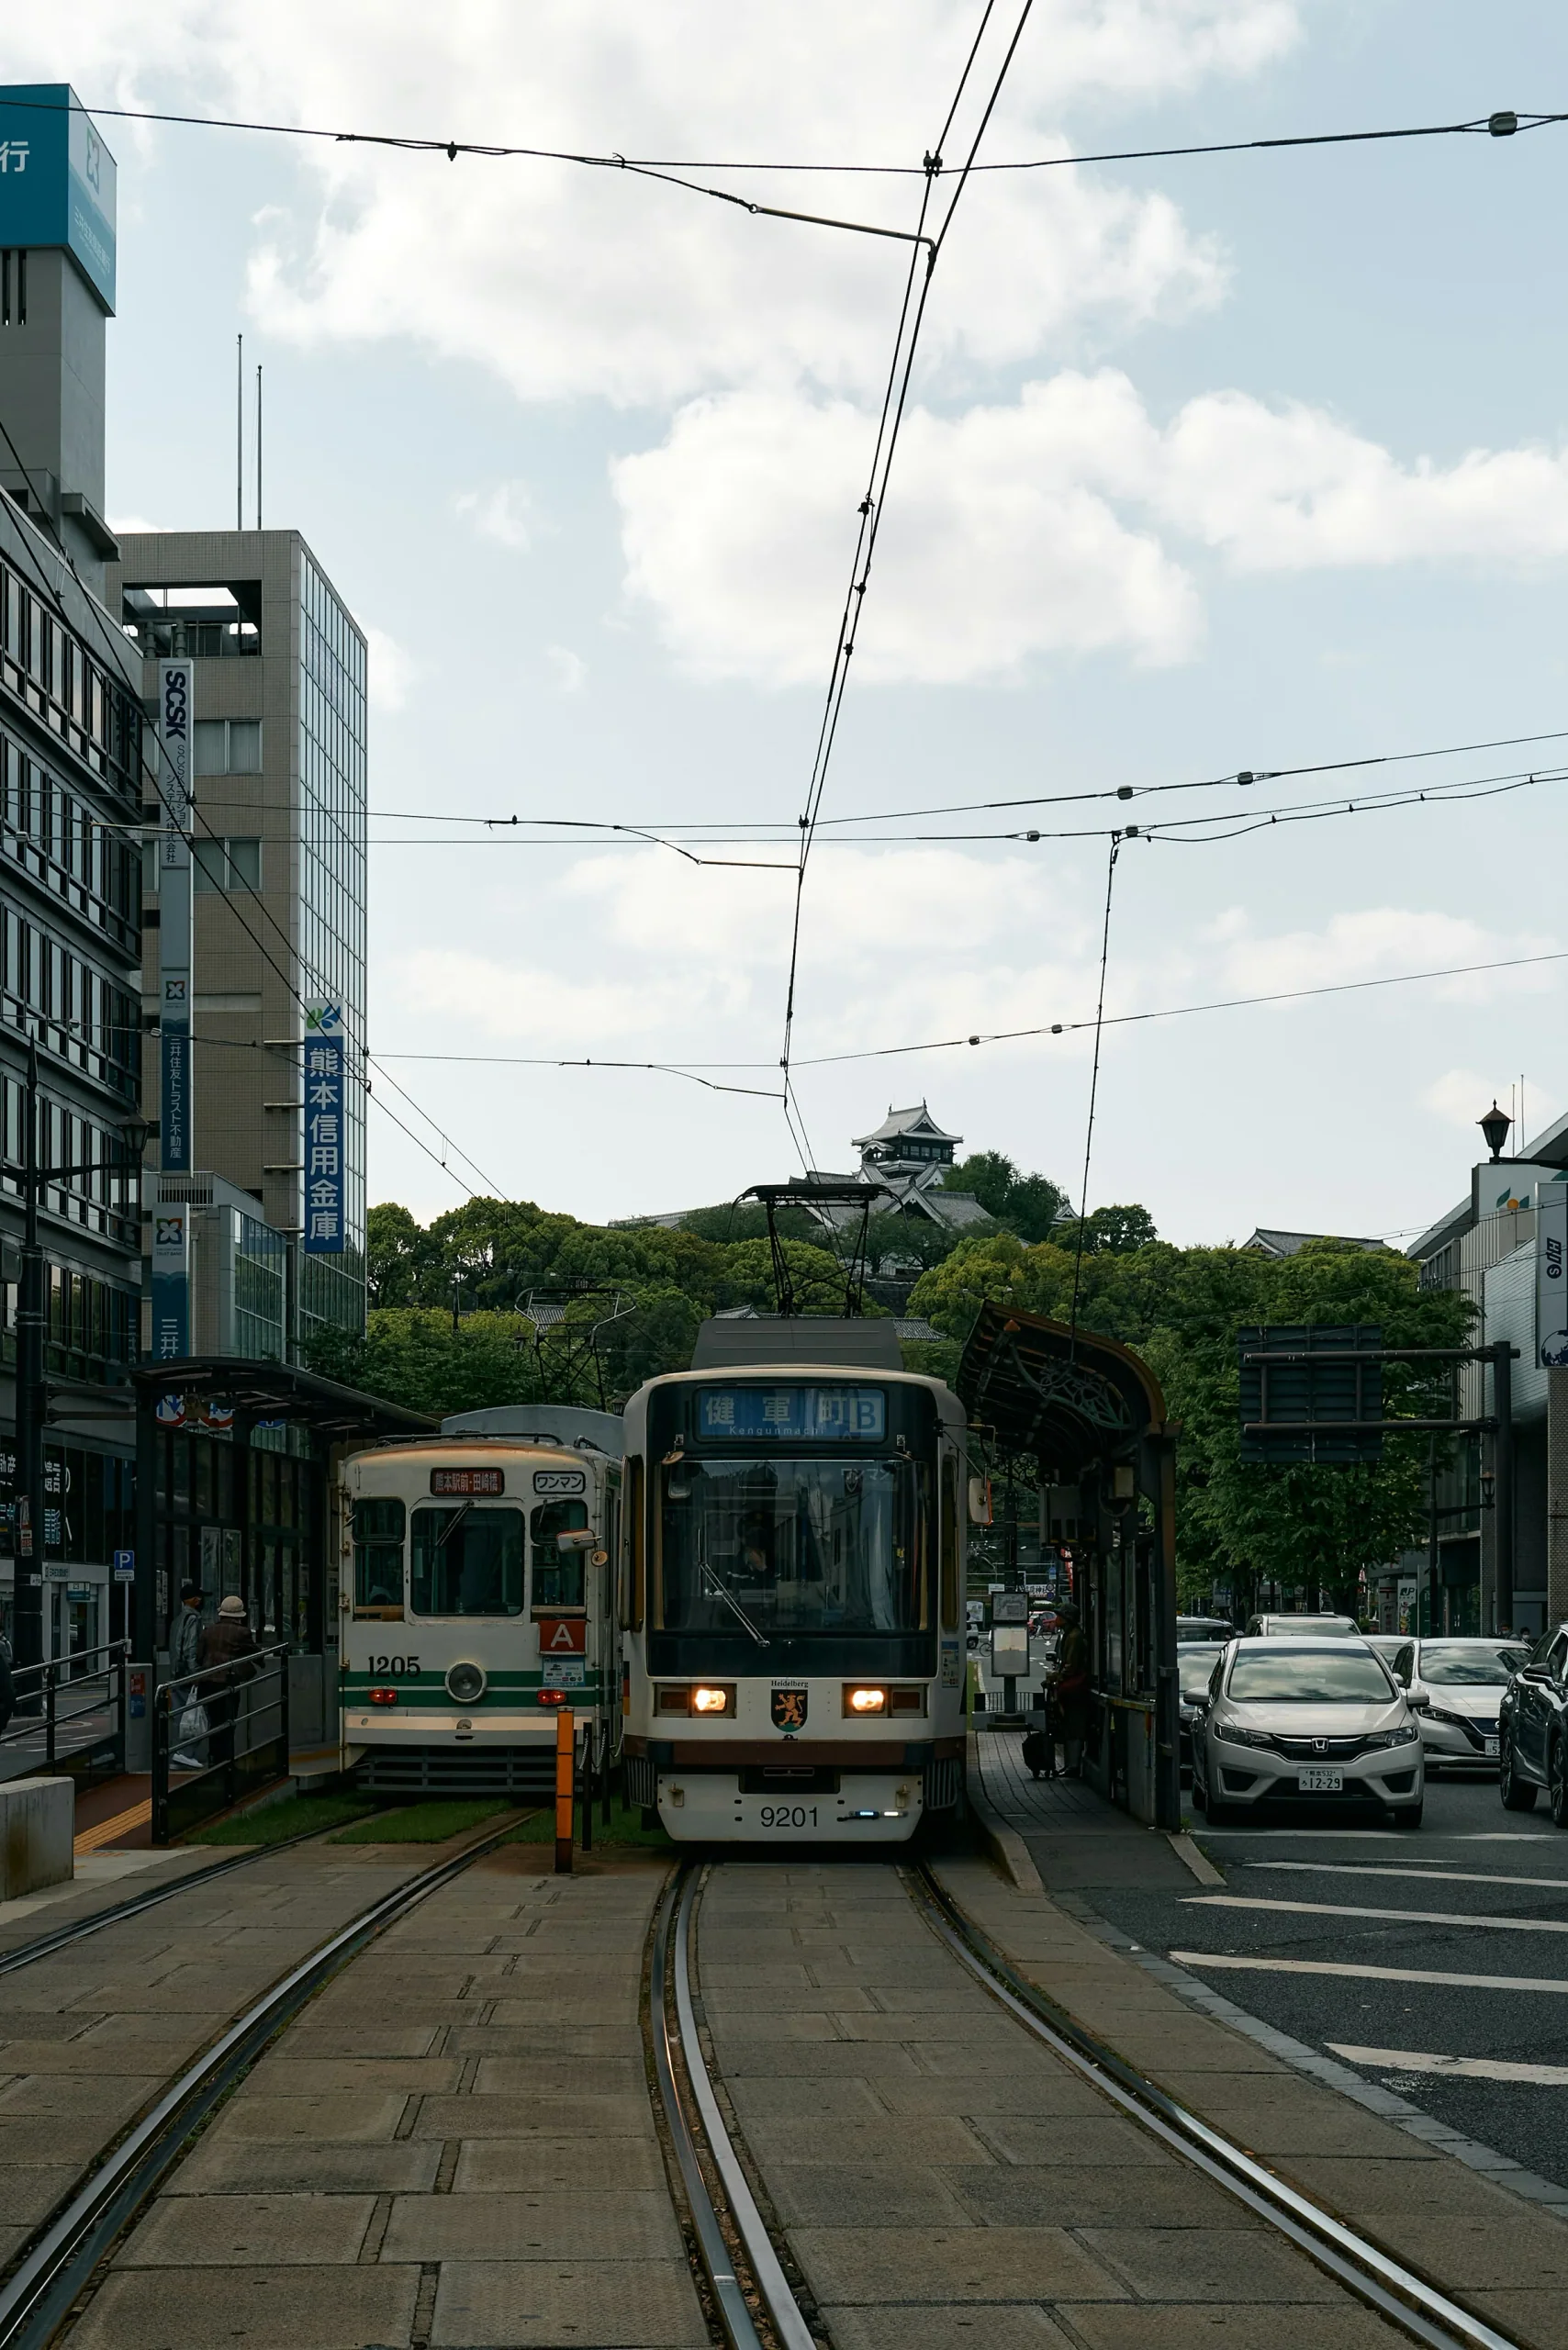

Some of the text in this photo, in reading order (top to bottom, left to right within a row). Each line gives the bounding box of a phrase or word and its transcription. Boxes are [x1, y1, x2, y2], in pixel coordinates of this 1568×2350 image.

[0, 140, 30, 173] 行
[165, 670, 186, 741] SCSK
[309, 1047, 339, 1240] 熊本信用金庫
[161, 1318, 179, 1360] 三井
[705, 1395, 847, 1426] 健軍町
[857, 1401, 877, 1429] B
[729, 1426, 824, 1437] Kengunmachi
[537, 1476, 582, 1489] ワンマン
[119, 1552, 130, 1569] P
[550, 1623, 574, 1648] A
[368, 1656, 421, 1678] 1205
[771, 1680, 809, 1688] Heidelberg
[1310, 1777, 1340, 1789] 12-29
[760, 1807, 819, 1828] 9201
